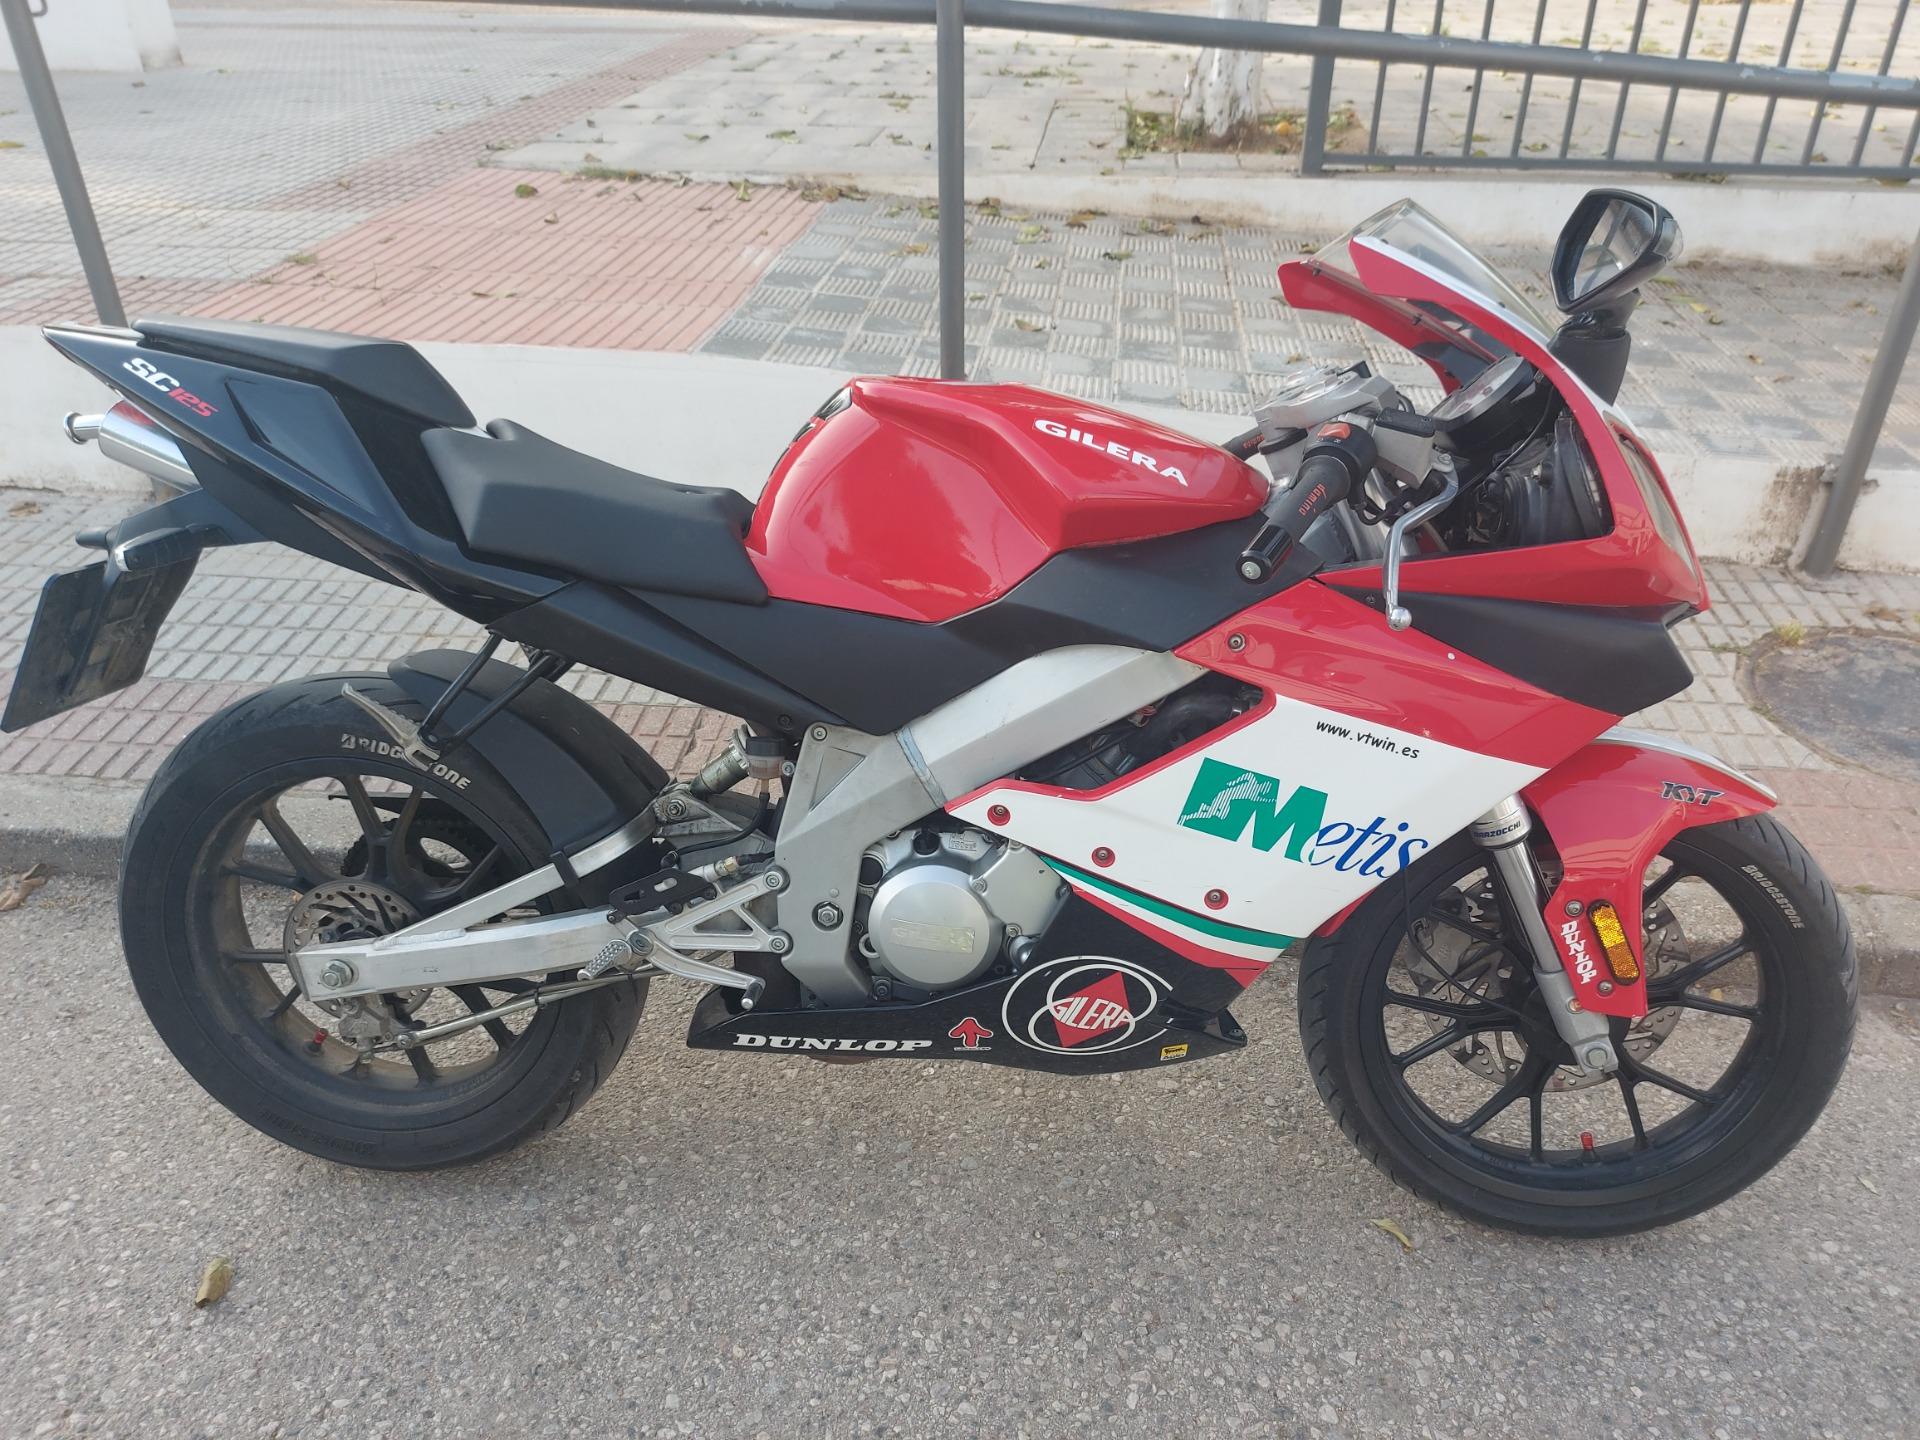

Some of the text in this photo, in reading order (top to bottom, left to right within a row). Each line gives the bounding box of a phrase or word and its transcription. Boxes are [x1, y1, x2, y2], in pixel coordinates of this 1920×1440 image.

[1034, 419, 1188, 487] GILERA
[341, 733, 471, 790] BRIDGONE
[1316, 720, 1420, 759] www.vtwin.es
[1177, 757, 1428, 879] Metis
[1662, 781, 1725, 805] KYT
[1741, 864, 1805, 928] BRIDGESTONE
[1561, 920, 1597, 985] DUNLOP
[1048, 996, 1134, 1030] GILERA
[733, 1033, 933, 1051] DUNLOP
